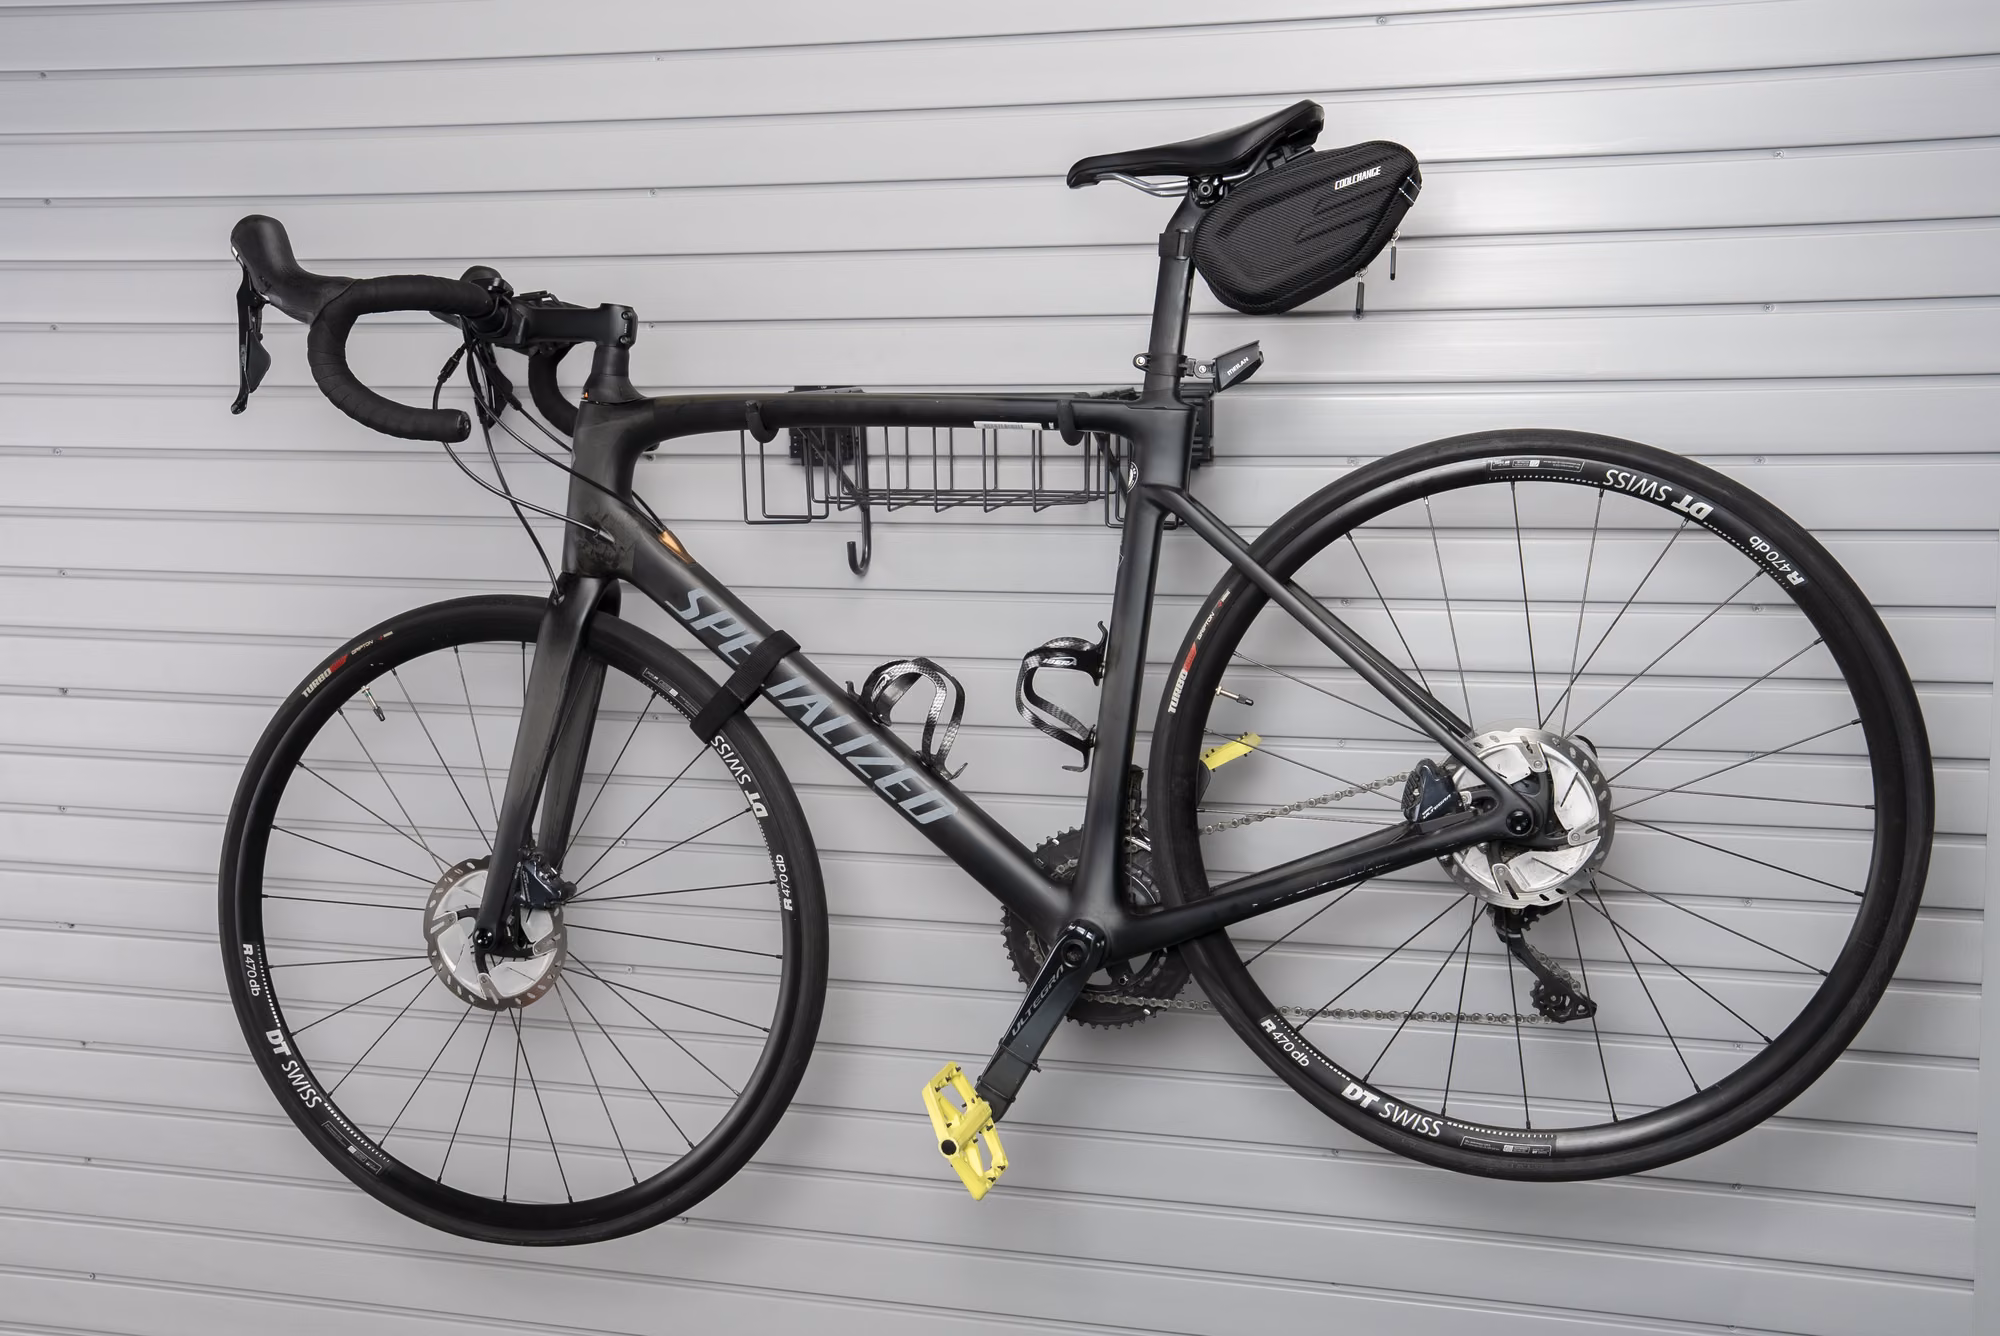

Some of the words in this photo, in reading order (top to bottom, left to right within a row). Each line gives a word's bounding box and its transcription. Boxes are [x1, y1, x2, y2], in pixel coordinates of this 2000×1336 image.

[1334, 165, 1382, 191] COOLCHANGE
[1602, 468, 1673, 502] SWISS
[1670, 494, 1715, 521] DT
[301, 667, 332, 698] TURBO
[1167, 668, 1188, 714] TURBO
[664, 587, 958, 825] SPEIALIZED
[710, 734, 751, 785] SWISS
[744, 789, 769, 818] DT
[1011, 964, 1064, 1037] ULTEGRA
[265, 1028, 292, 1056] DT
[281, 1060, 322, 1108] SWISS
[1341, 1081, 1381, 1108] DT
[1378, 1102, 1444, 1138] SWISS
